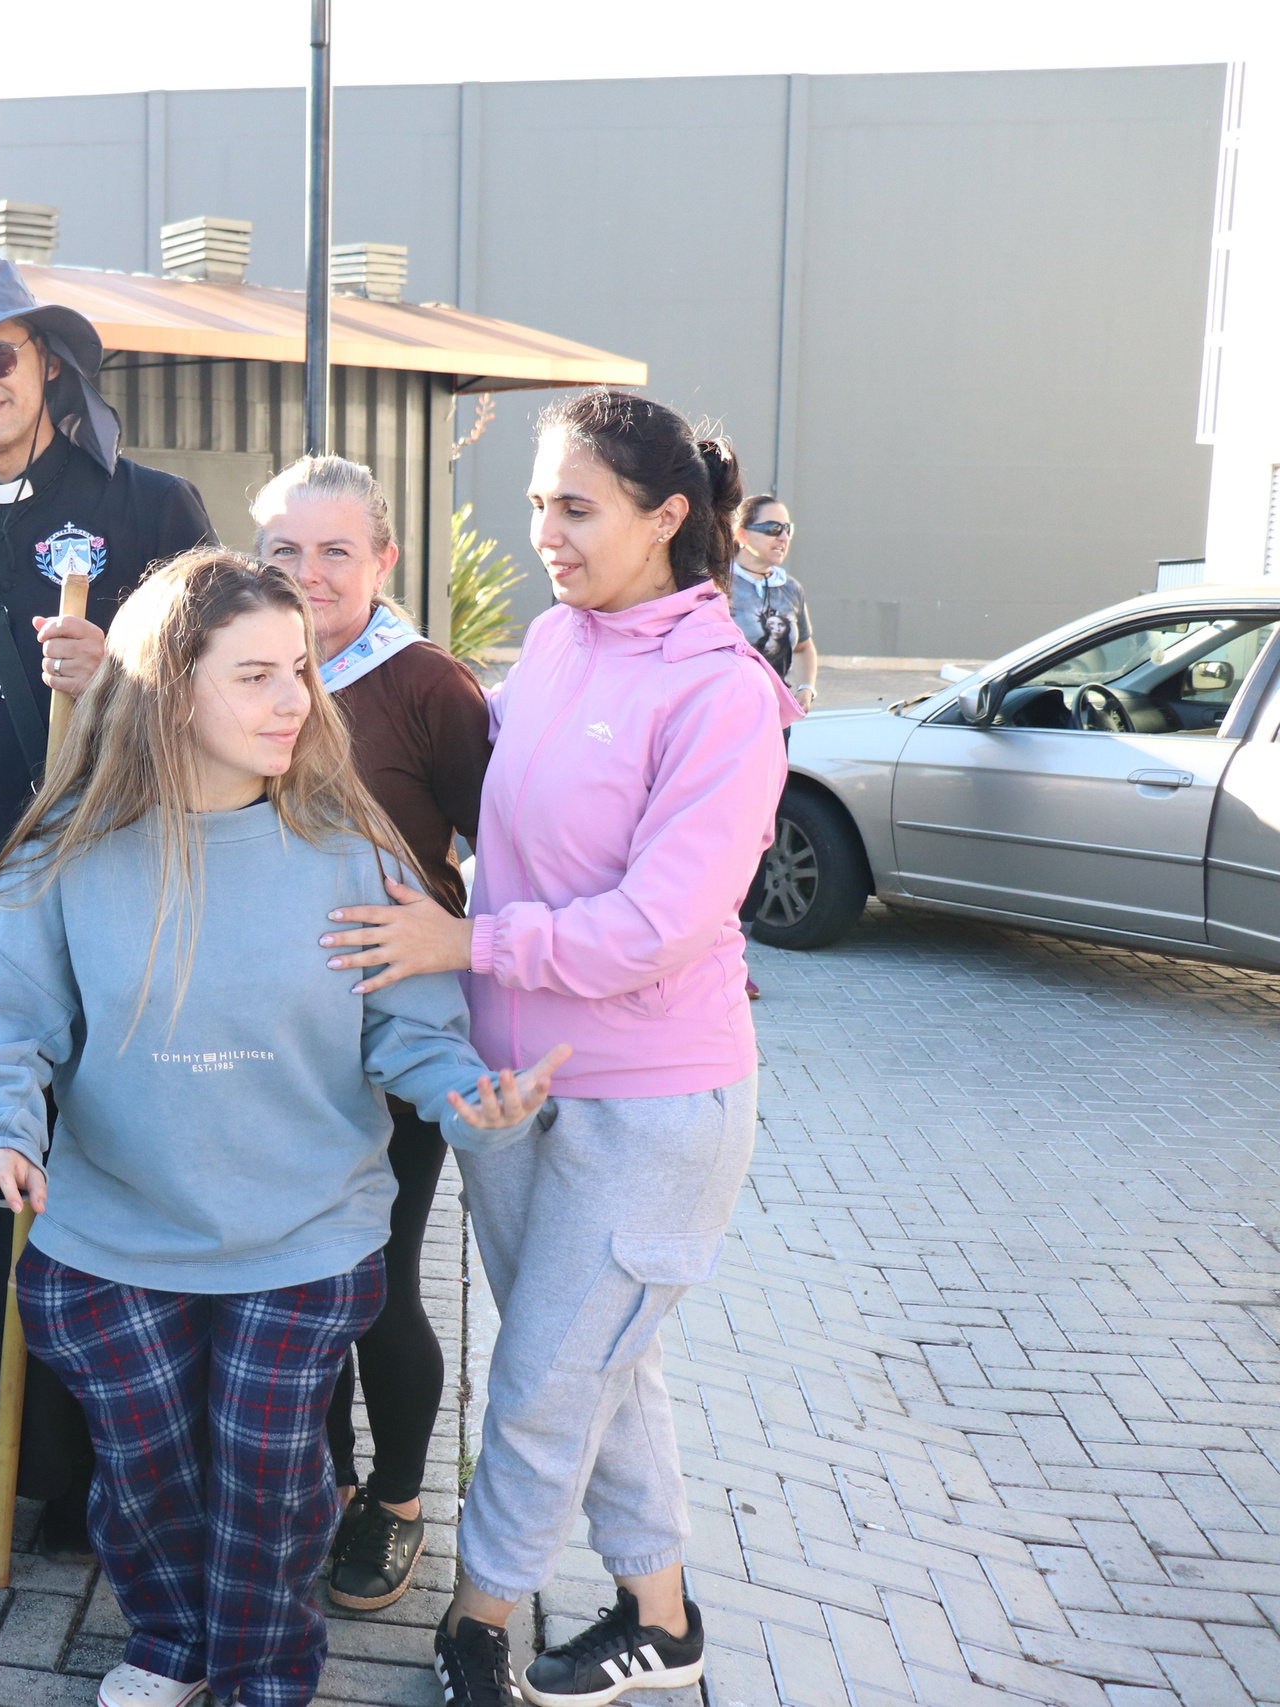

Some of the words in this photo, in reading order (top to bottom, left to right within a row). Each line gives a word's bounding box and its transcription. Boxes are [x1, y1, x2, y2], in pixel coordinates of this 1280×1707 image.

[152, 1053, 200, 1062] TOMMY
[219, 1050, 274, 1061] HILFIGER
[192, 1063, 212, 1072] EST.
[214, 1061, 234, 1071] 1985
